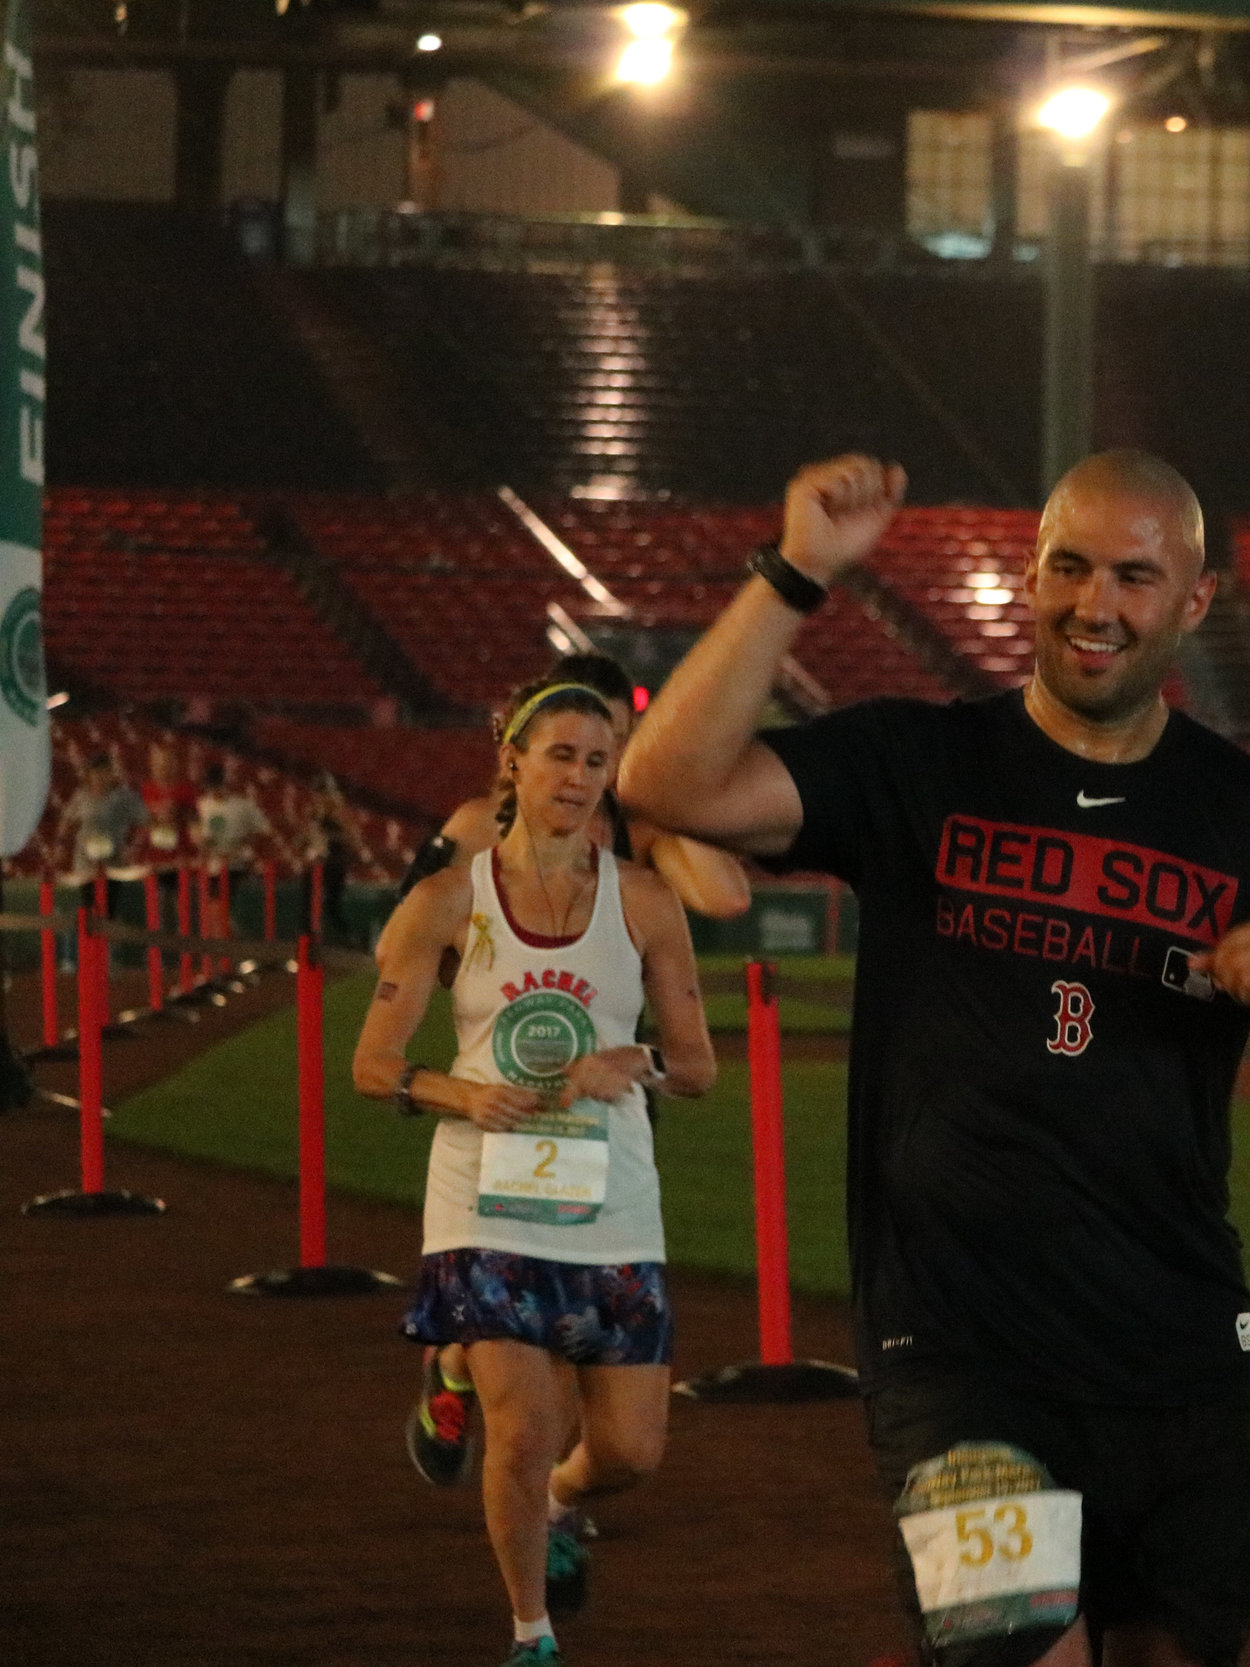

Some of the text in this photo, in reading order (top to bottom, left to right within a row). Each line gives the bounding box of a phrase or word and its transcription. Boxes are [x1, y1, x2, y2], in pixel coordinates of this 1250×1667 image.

[4, 40, 46, 487] FINISH
[944, 823, 1228, 938] RED SOX
[936, 895, 1151, 978] BASEBALL
[501, 968, 599, 1007] RACHEL
[1047, 980, 1096, 1057] B
[528, 1024, 561, 1038] 2017
[533, 1139, 558, 1179] 2
[954, 1501, 1034, 1568] 53
